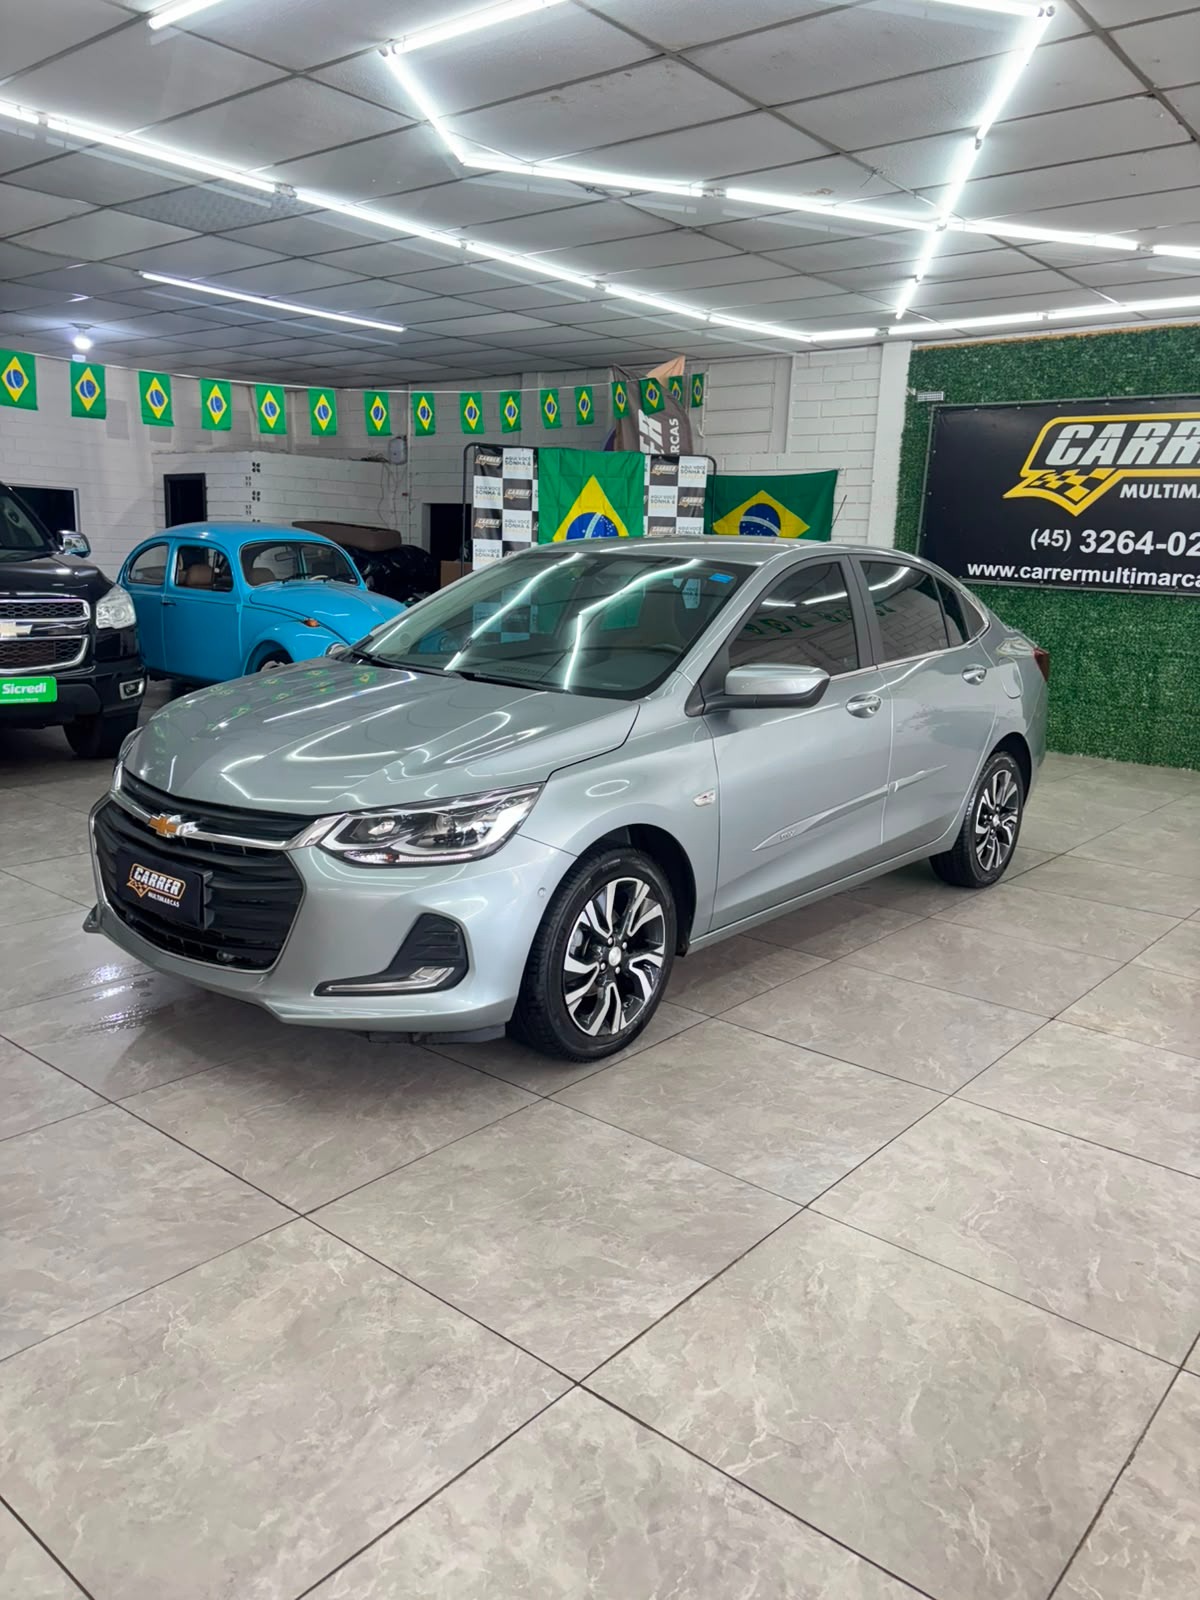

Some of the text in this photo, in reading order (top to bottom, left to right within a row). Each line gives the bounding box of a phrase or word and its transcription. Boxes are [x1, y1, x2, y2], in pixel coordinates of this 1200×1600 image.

[1045, 421, 1200, 466] CARR
[1030, 528, 1072, 551] (45)
[967, 563, 1200, 587] www.carrermultimarca
[2, 682, 47, 694] Sicredi
[133, 867, 181, 895] CARRER
